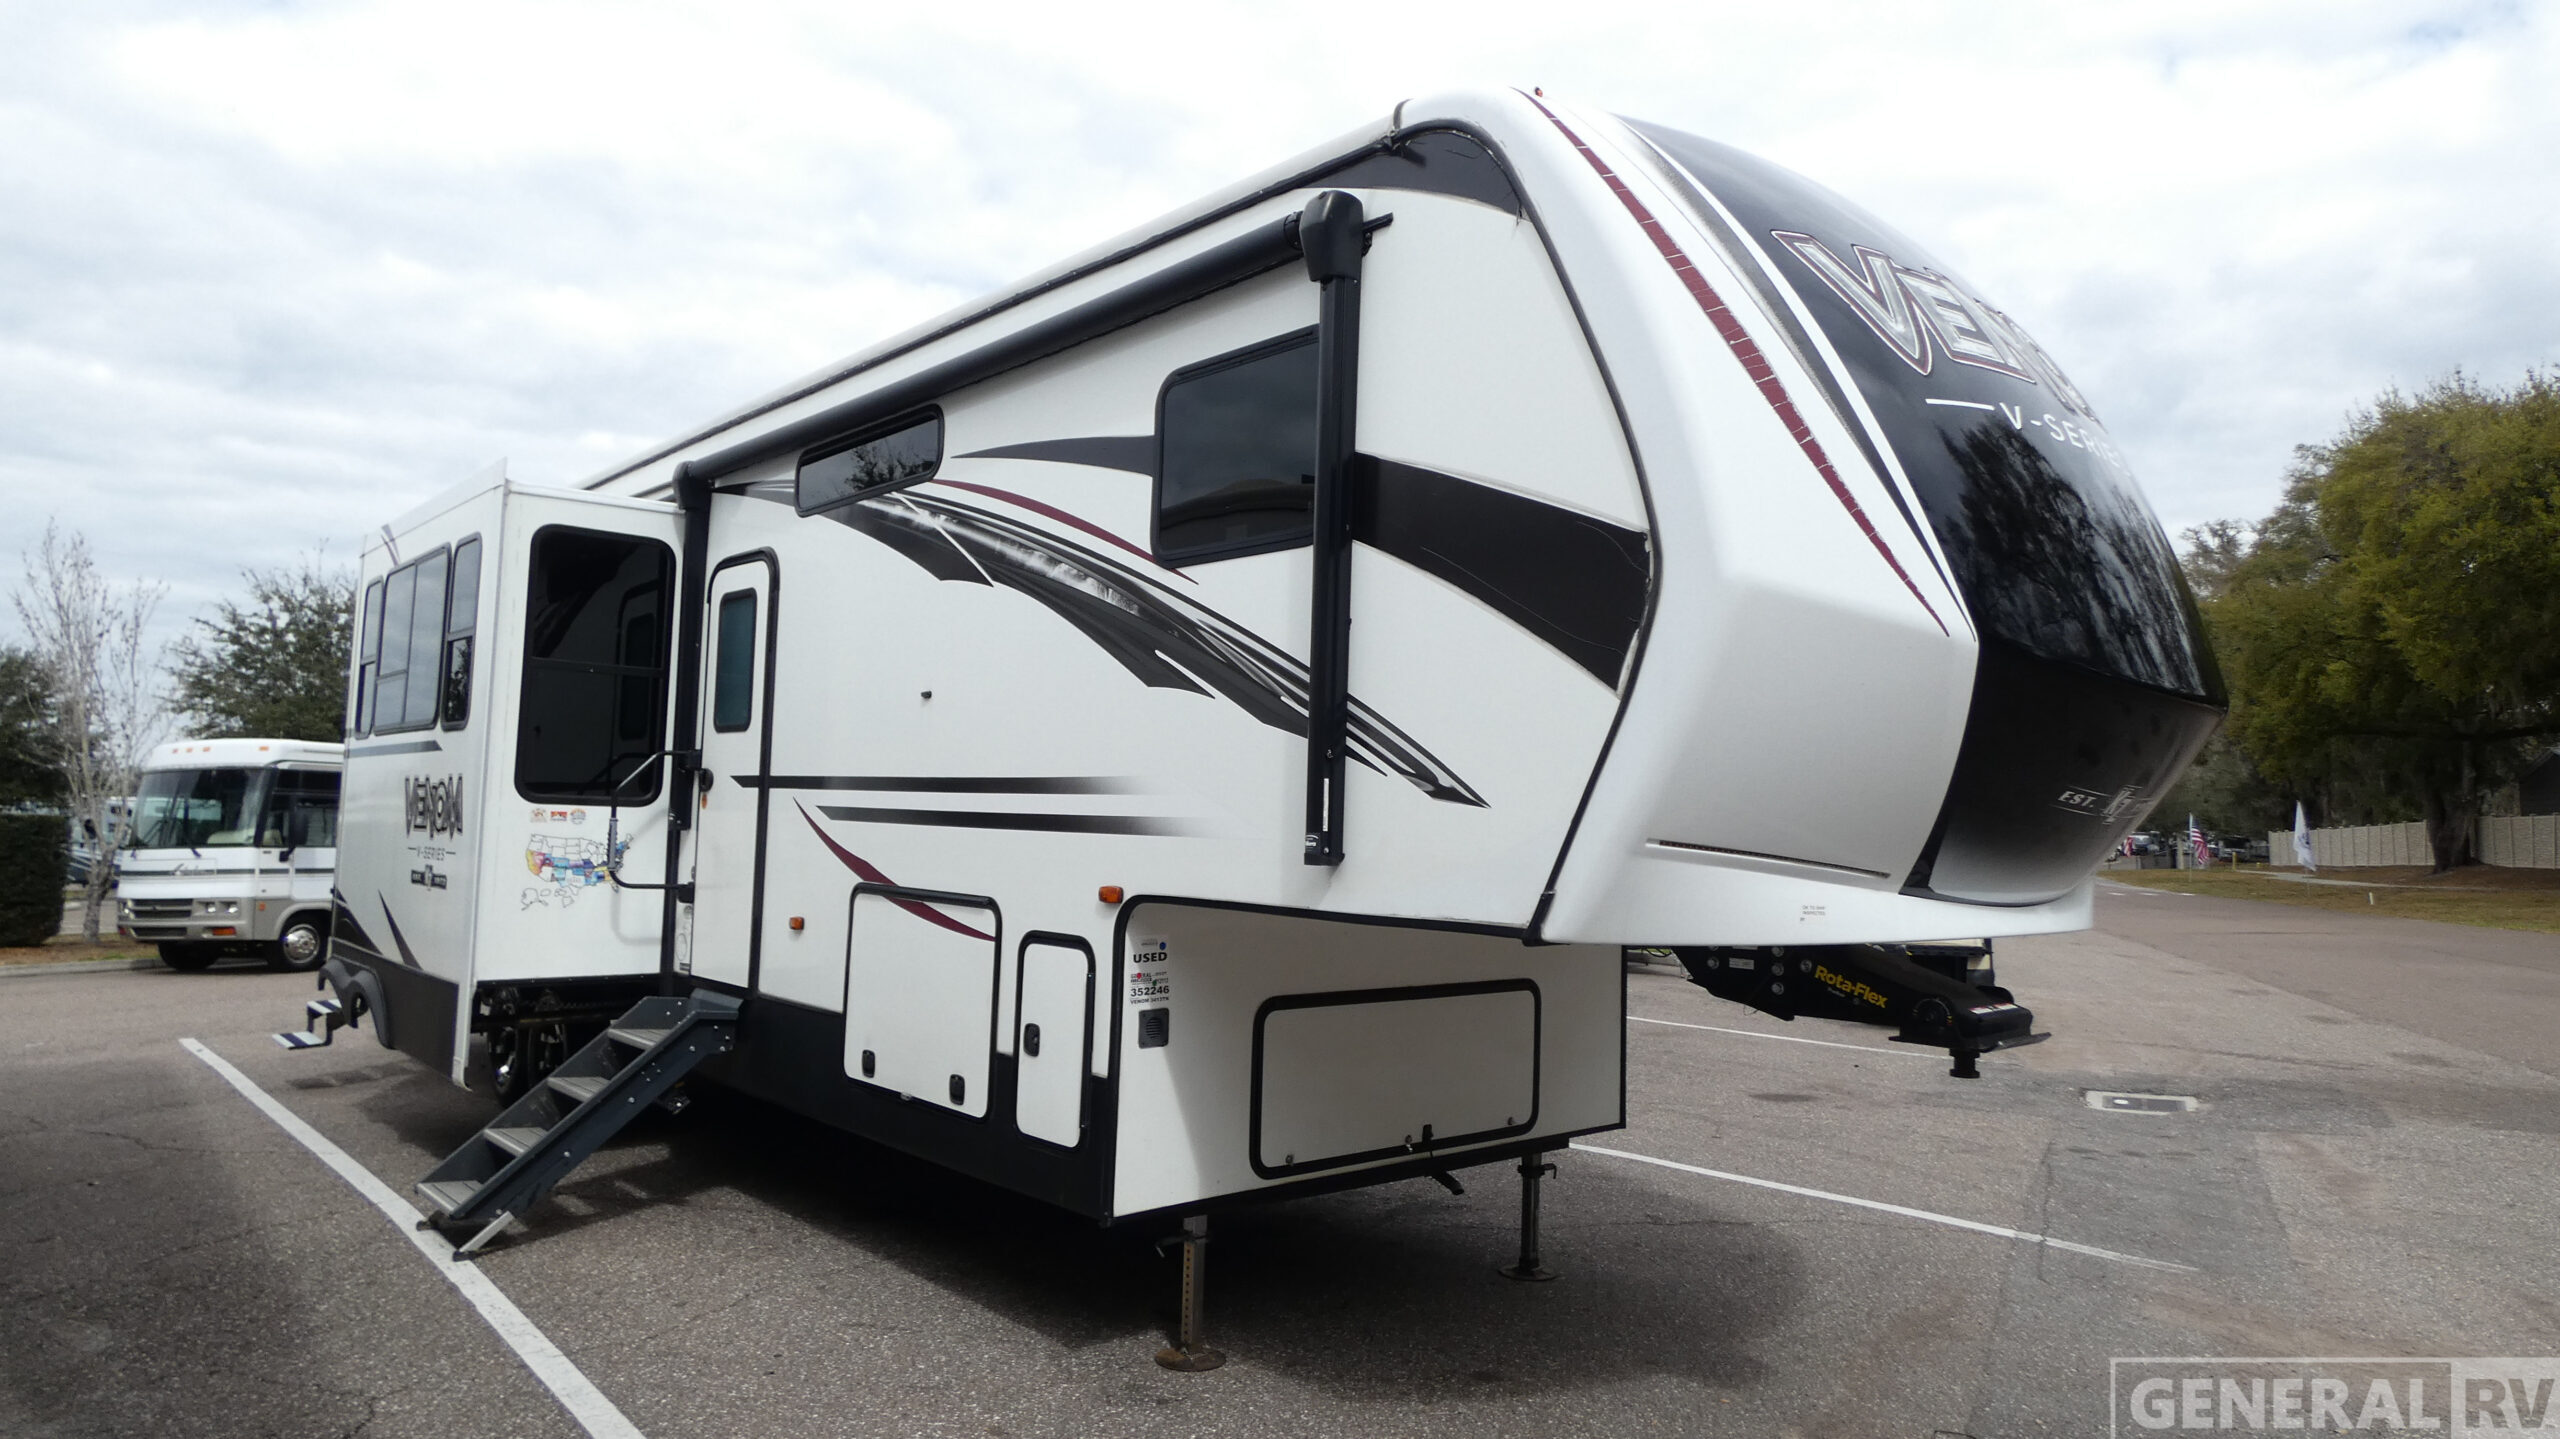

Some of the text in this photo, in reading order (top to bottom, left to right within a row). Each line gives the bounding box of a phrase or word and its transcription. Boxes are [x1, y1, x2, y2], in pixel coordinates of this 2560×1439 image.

[2057, 790, 2097, 808] EST.
[1133, 952, 1168, 964] USED
[1130, 985, 1170, 997] 352246
[1813, 965, 1889, 1008] Rota-Flex
